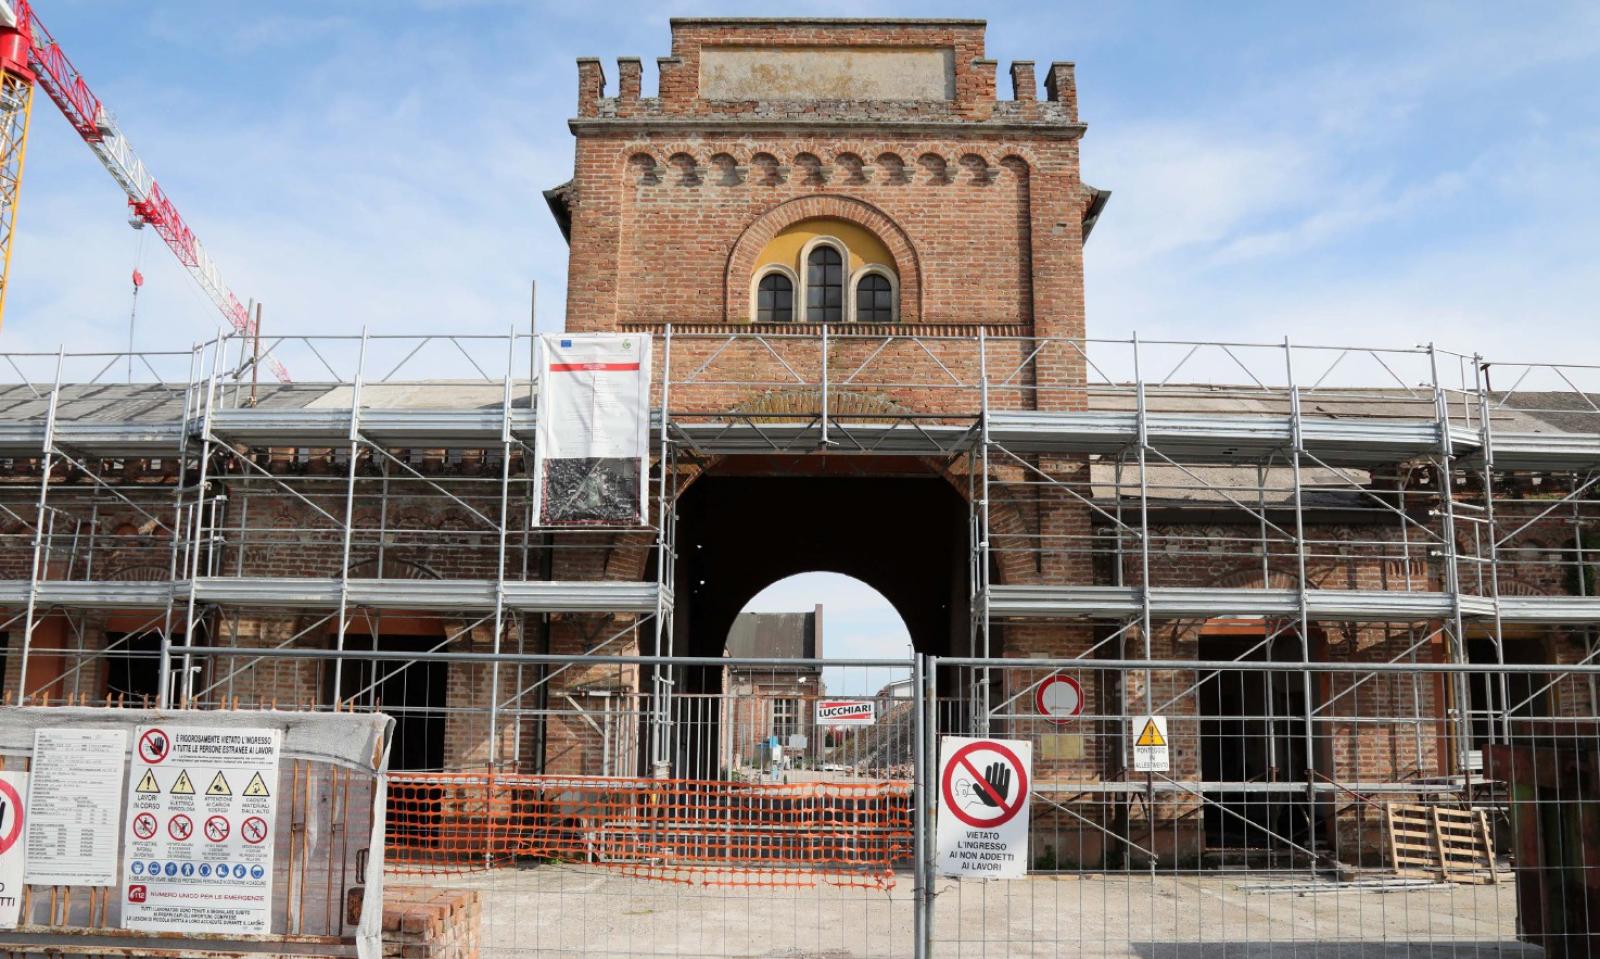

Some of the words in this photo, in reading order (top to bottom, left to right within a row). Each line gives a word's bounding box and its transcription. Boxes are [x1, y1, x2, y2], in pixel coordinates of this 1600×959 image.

[818, 704, 872, 718] LUCCHIARI
[180, 734, 221, 743] RIGOROSAMENTE
[221, 735, 241, 744] VIETATO
[241, 735, 272, 745] L'INGRESSO
[172, 744, 177, 752] A
[177, 744, 191, 753] TUTTE
[192, 745, 198, 753] LE
[199, 745, 222, 754] PERSONE
[222, 745, 248, 755] ESTRANEE
[249, 746, 255, 754] AI
[255, 746, 274, 756] LAVORI
[966, 831, 1000, 841] VIETATO
[957, 841, 1007, 851] L'INGRESSO
[949, 850, 958, 859] AI
[959, 851, 978, 860] NON
[979, 852, 1015, 861] ADDETTI
[961, 861, 970, 870] AI
[971, 862, 1002, 871] LAVORI
